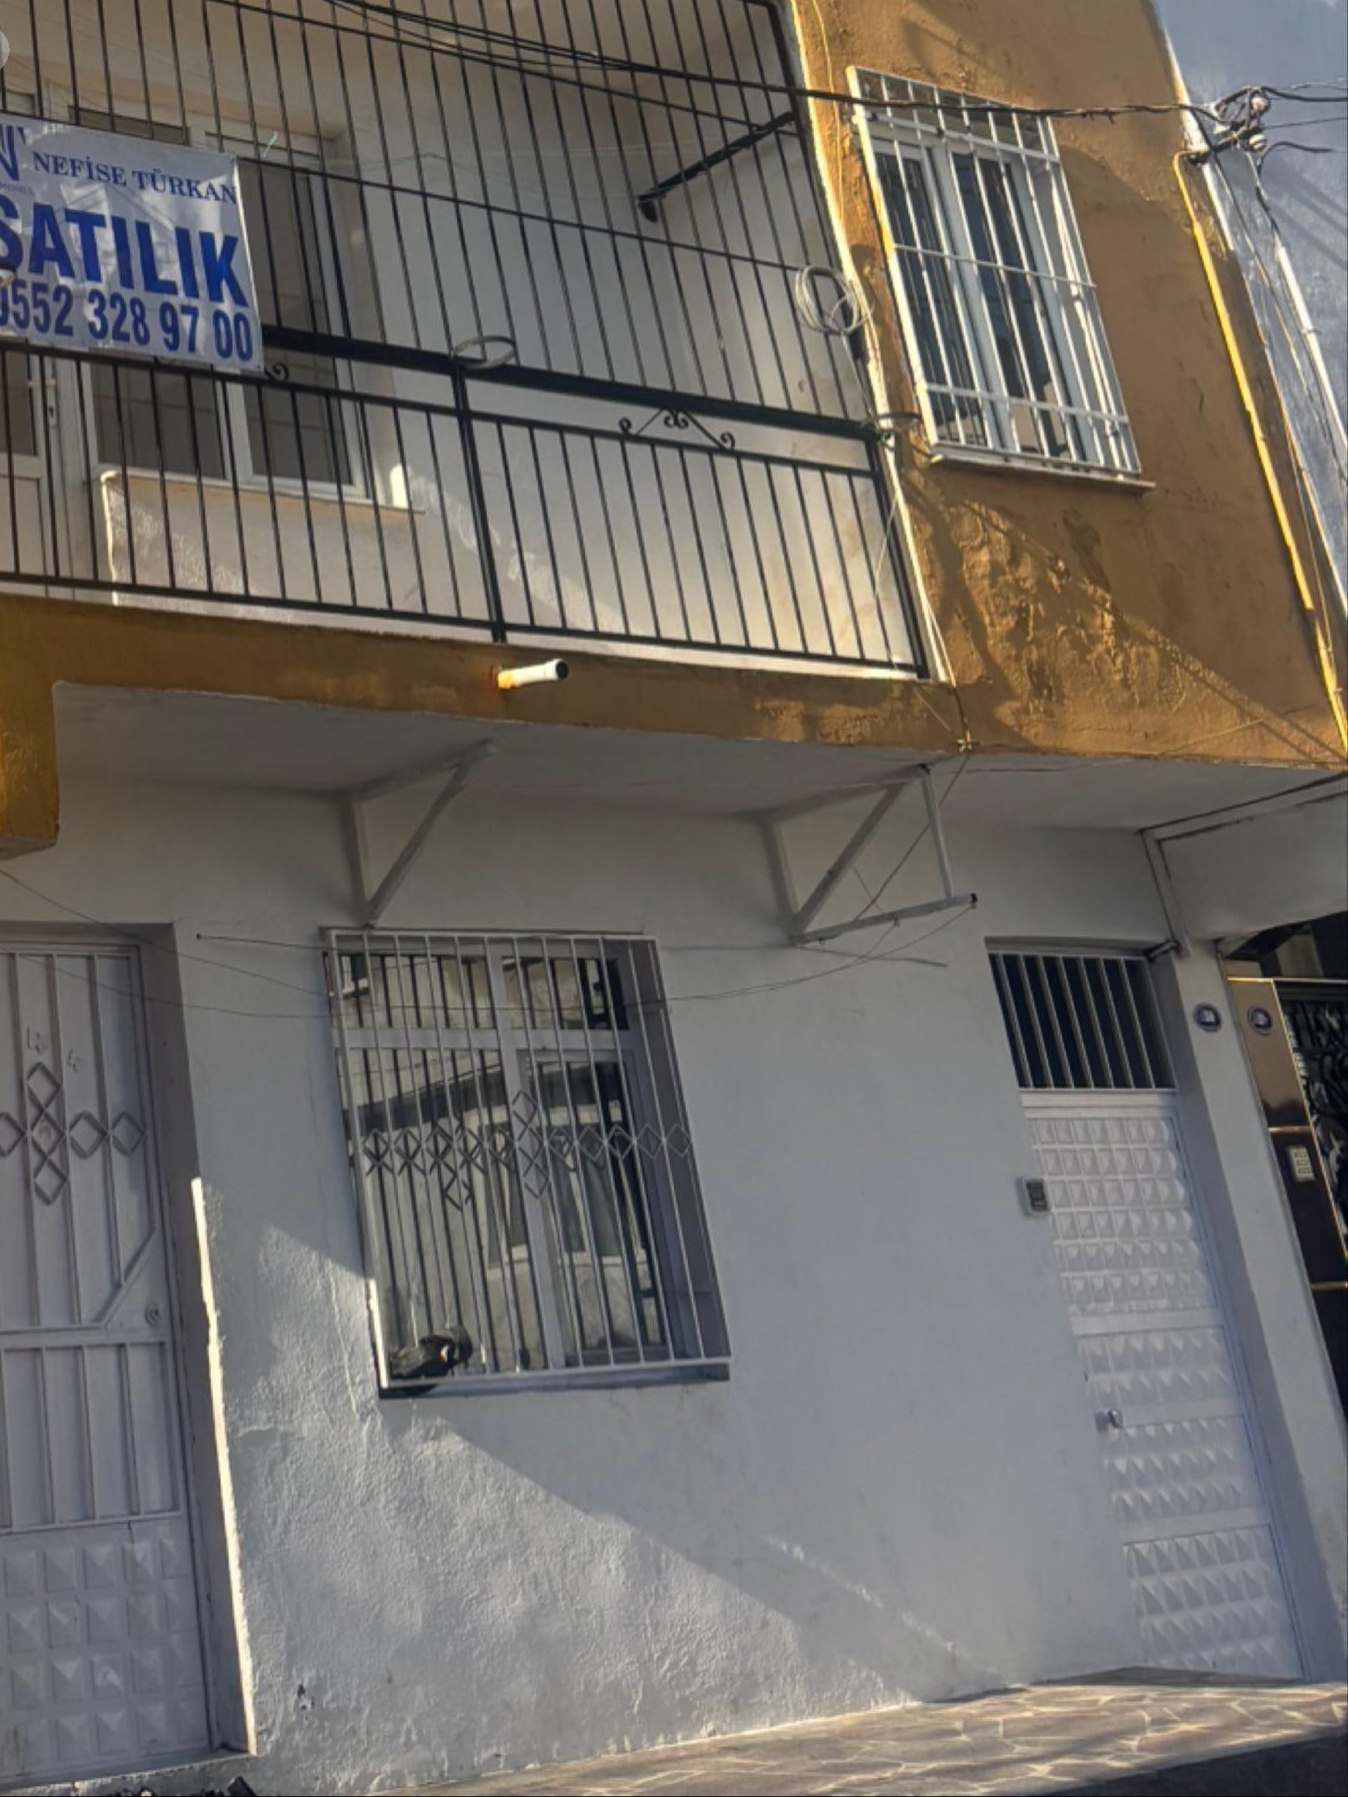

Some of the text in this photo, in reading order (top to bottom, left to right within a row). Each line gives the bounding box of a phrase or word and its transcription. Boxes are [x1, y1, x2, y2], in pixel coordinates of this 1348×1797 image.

[32, 152, 127, 187] NEFİSE
[132, 169, 238, 205] TÜRKAN
[89, 288, 151, 346] 328
[160, 301, 200, 353] 97
[212, 309, 253, 361] 00
